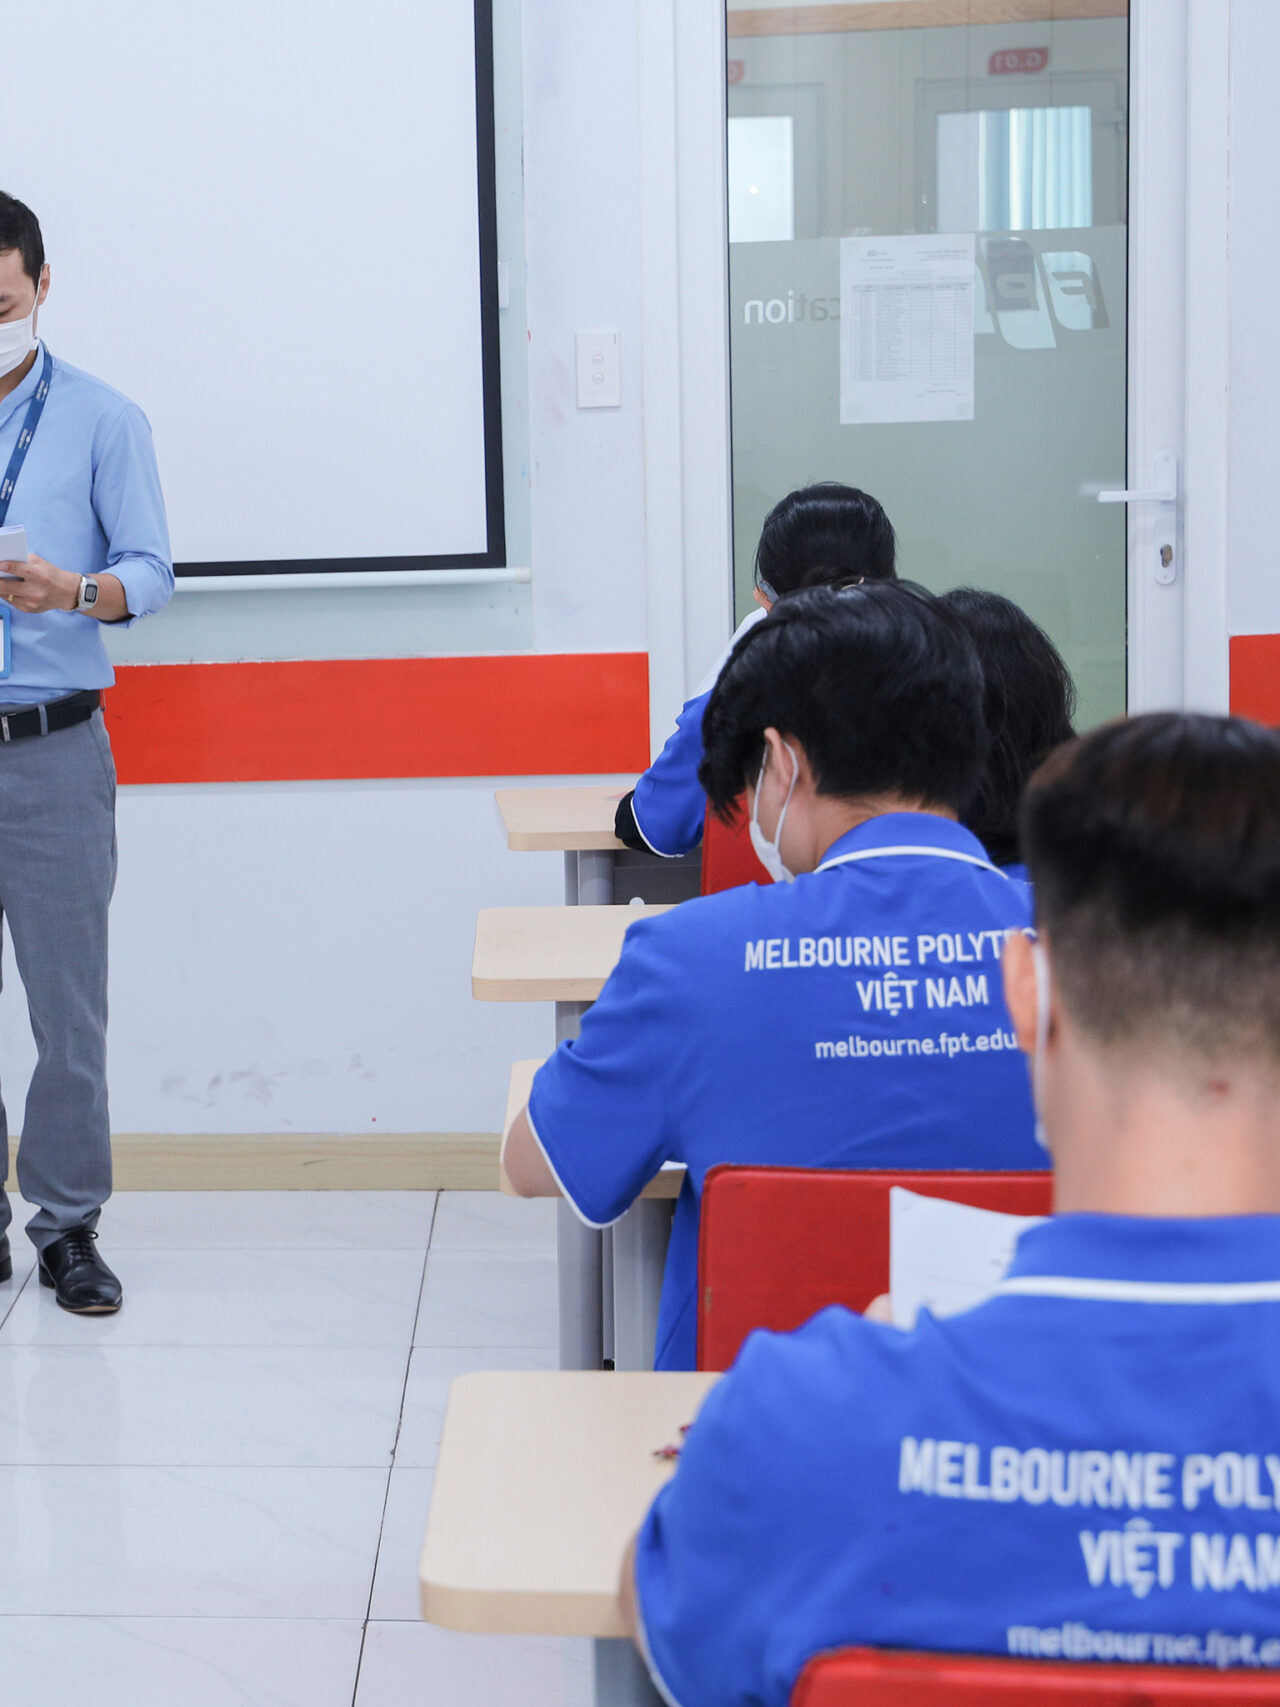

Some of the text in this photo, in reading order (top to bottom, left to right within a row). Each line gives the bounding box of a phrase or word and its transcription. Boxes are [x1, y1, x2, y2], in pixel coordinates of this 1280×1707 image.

[744, 935, 911, 973] MELBOURNE
[855, 971, 989, 1017] VIỆT NAM
[815, 1027, 1019, 1059] melbourne.fpt.edu
[898, 1436, 1174, 1510] MELBOURNE
[1078, 1517, 1184, 1599] VIỆT
